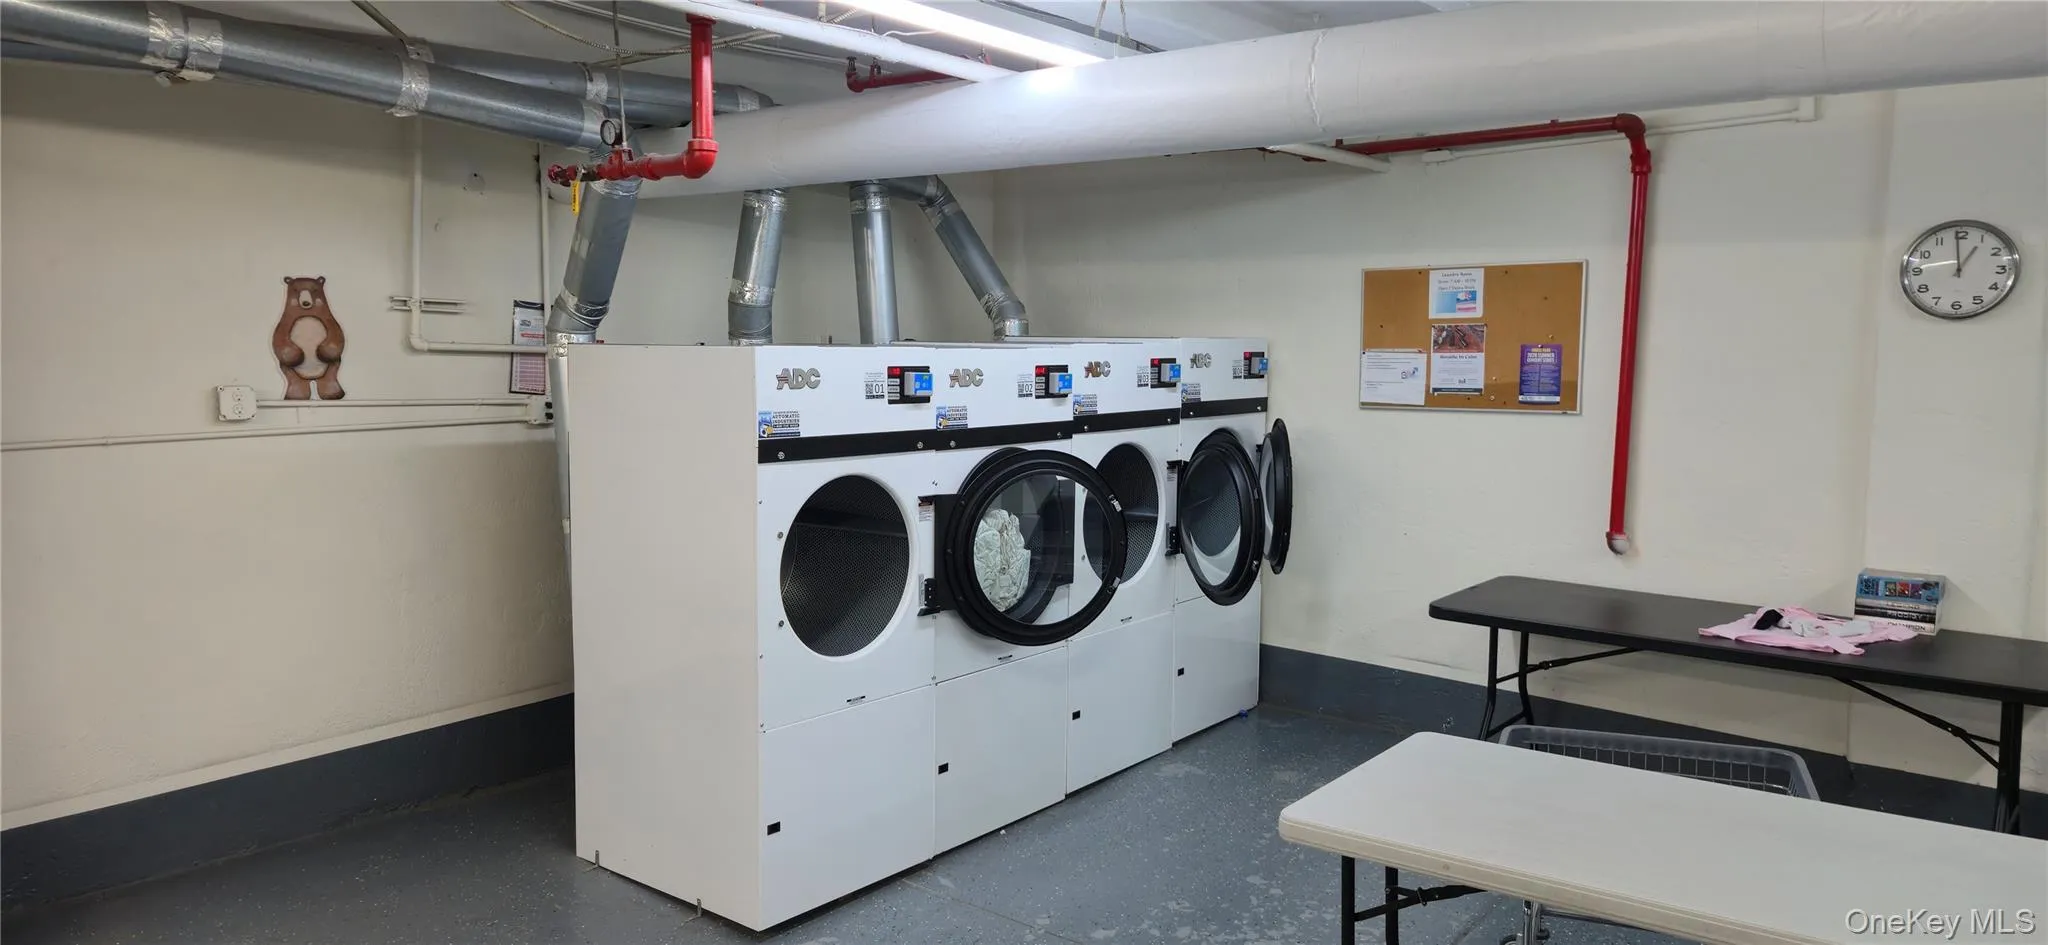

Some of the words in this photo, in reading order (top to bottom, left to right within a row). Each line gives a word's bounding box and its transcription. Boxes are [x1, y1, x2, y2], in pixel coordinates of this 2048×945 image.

[1955, 230, 1969, 240] 12
[1980, 234, 1985, 243] 1
[1935, 237, 1944, 246] 11
[1919, 250, 1931, 259] 10
[1990, 247, 2002, 257] 2
[1912, 267, 1923, 276] 9
[1995, 265, 2007, 274] 3
[1917, 284, 1929, 293] 8
[1988, 282, 1999, 291] 4
[1932, 296, 1941, 306] 7
[1972, 296, 1984, 305] 5
[1951, 301, 1962, 310] 6
[1084, 361, 1112, 378] ADC
[776, 367, 821, 390] ADC
[949, 368, 984, 388] ADC
[874, 383, 885, 394] 01
[1025, 383, 1033, 393] 02
[1887, 610, 1922, 620] PRODIGY
